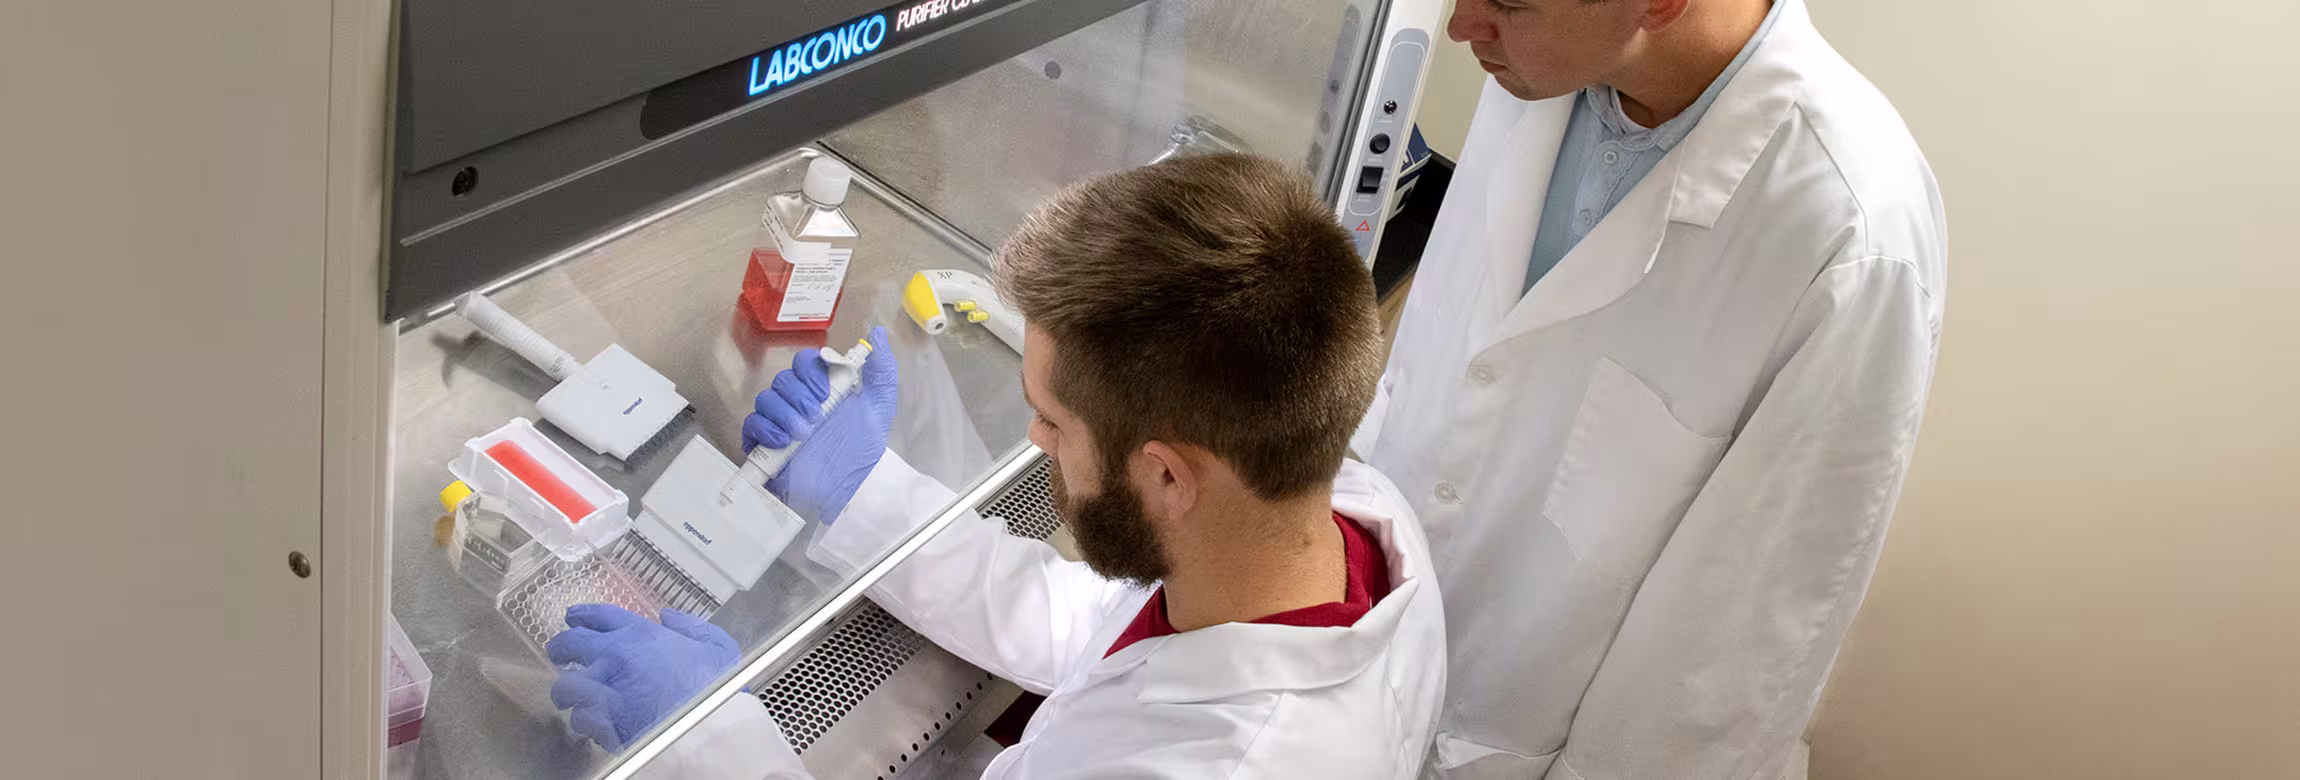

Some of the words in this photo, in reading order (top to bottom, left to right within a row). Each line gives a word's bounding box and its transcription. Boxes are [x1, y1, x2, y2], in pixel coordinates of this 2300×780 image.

[748, 14, 887, 96] LABCONCO
[896, 0, 950, 31] PURIFIER
[683, 521, 712, 545] eppendorf
